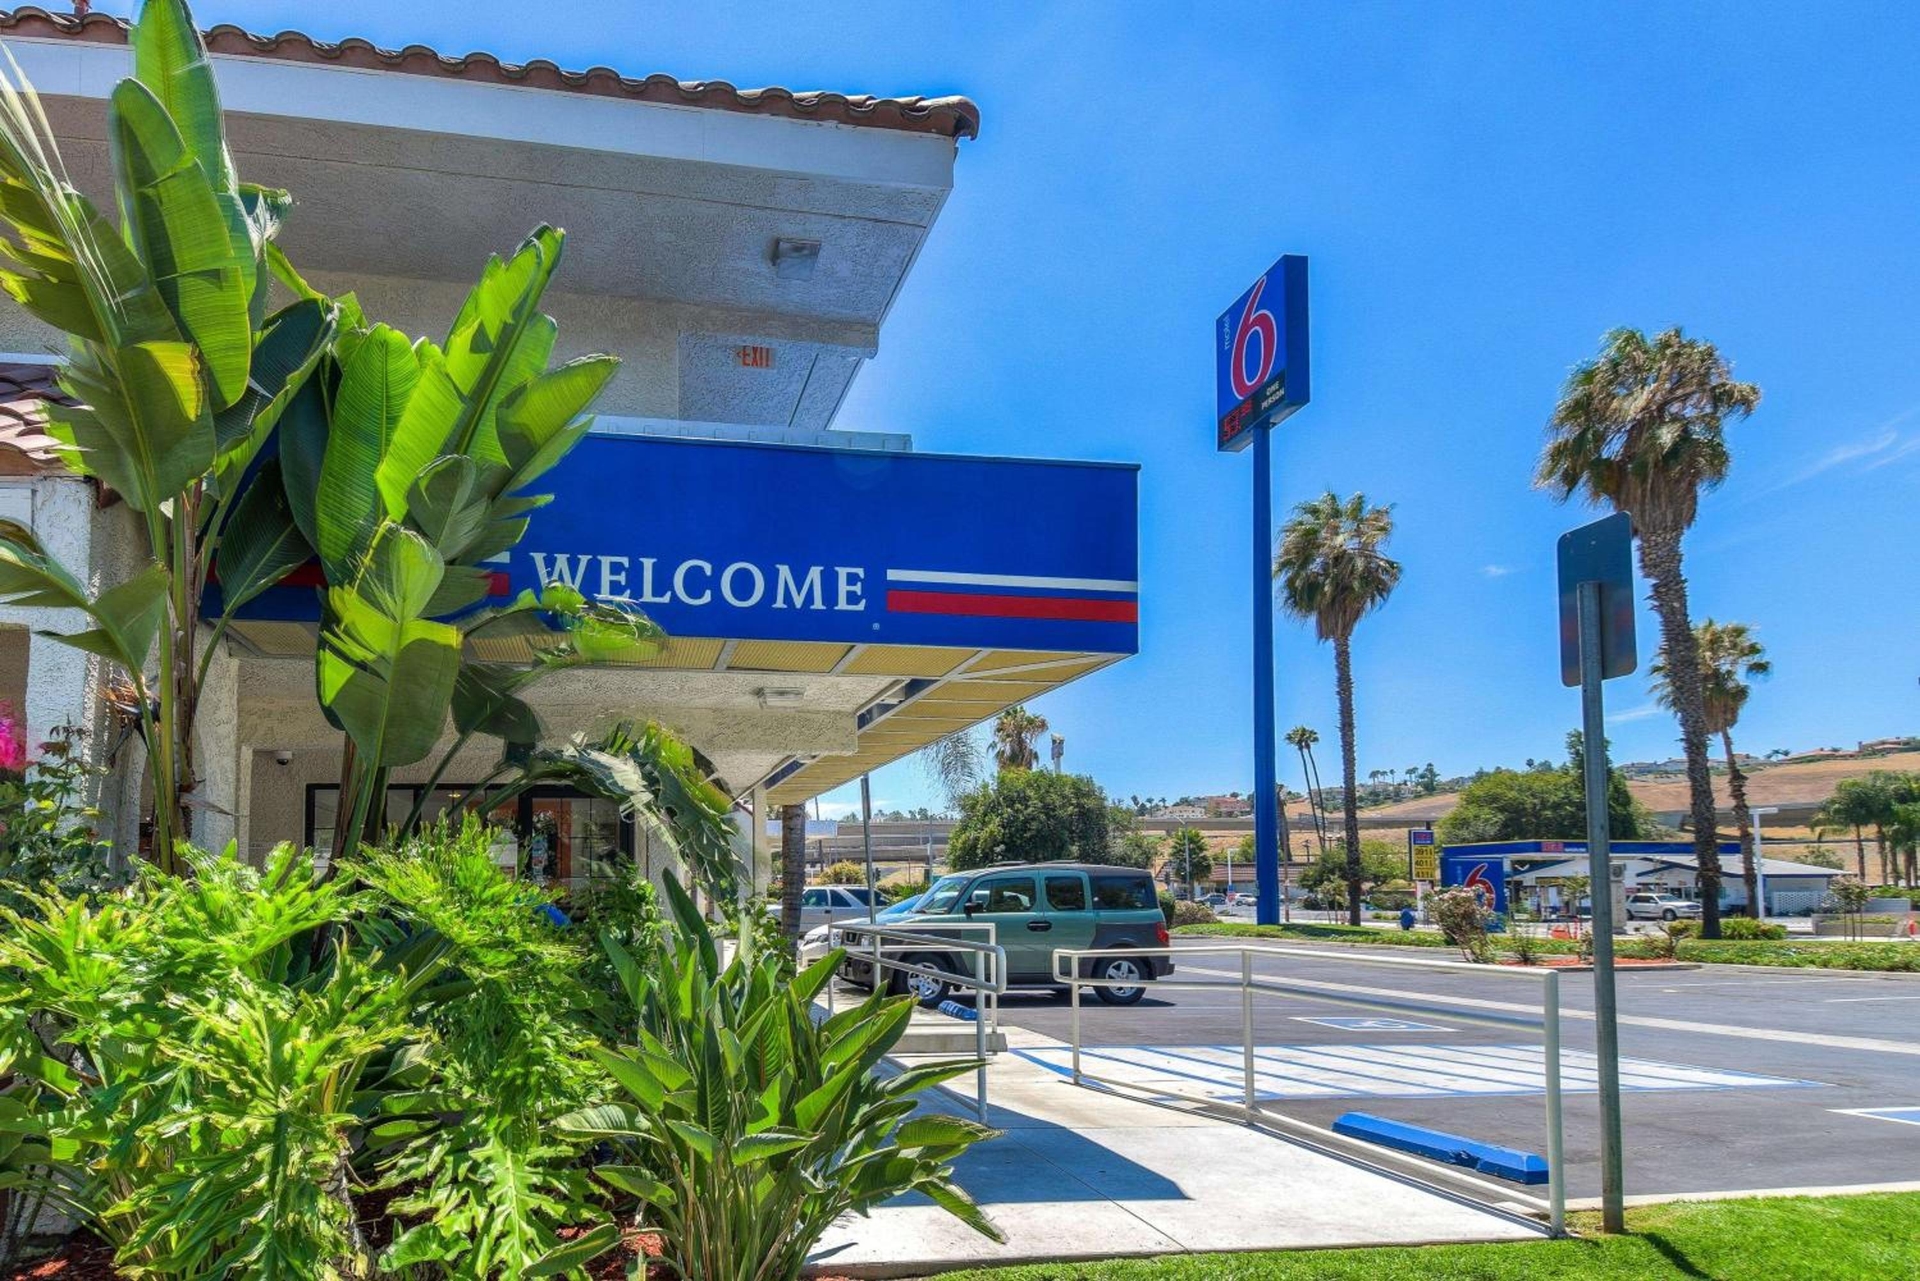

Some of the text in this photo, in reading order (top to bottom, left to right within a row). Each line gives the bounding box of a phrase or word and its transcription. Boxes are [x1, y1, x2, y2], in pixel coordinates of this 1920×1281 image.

[742, 345, 773, 367] EXIT
[1231, 275, 1278, 400] 6
[1261, 387, 1285, 411] PERSON
[529, 552, 867, 612] WELCOME
